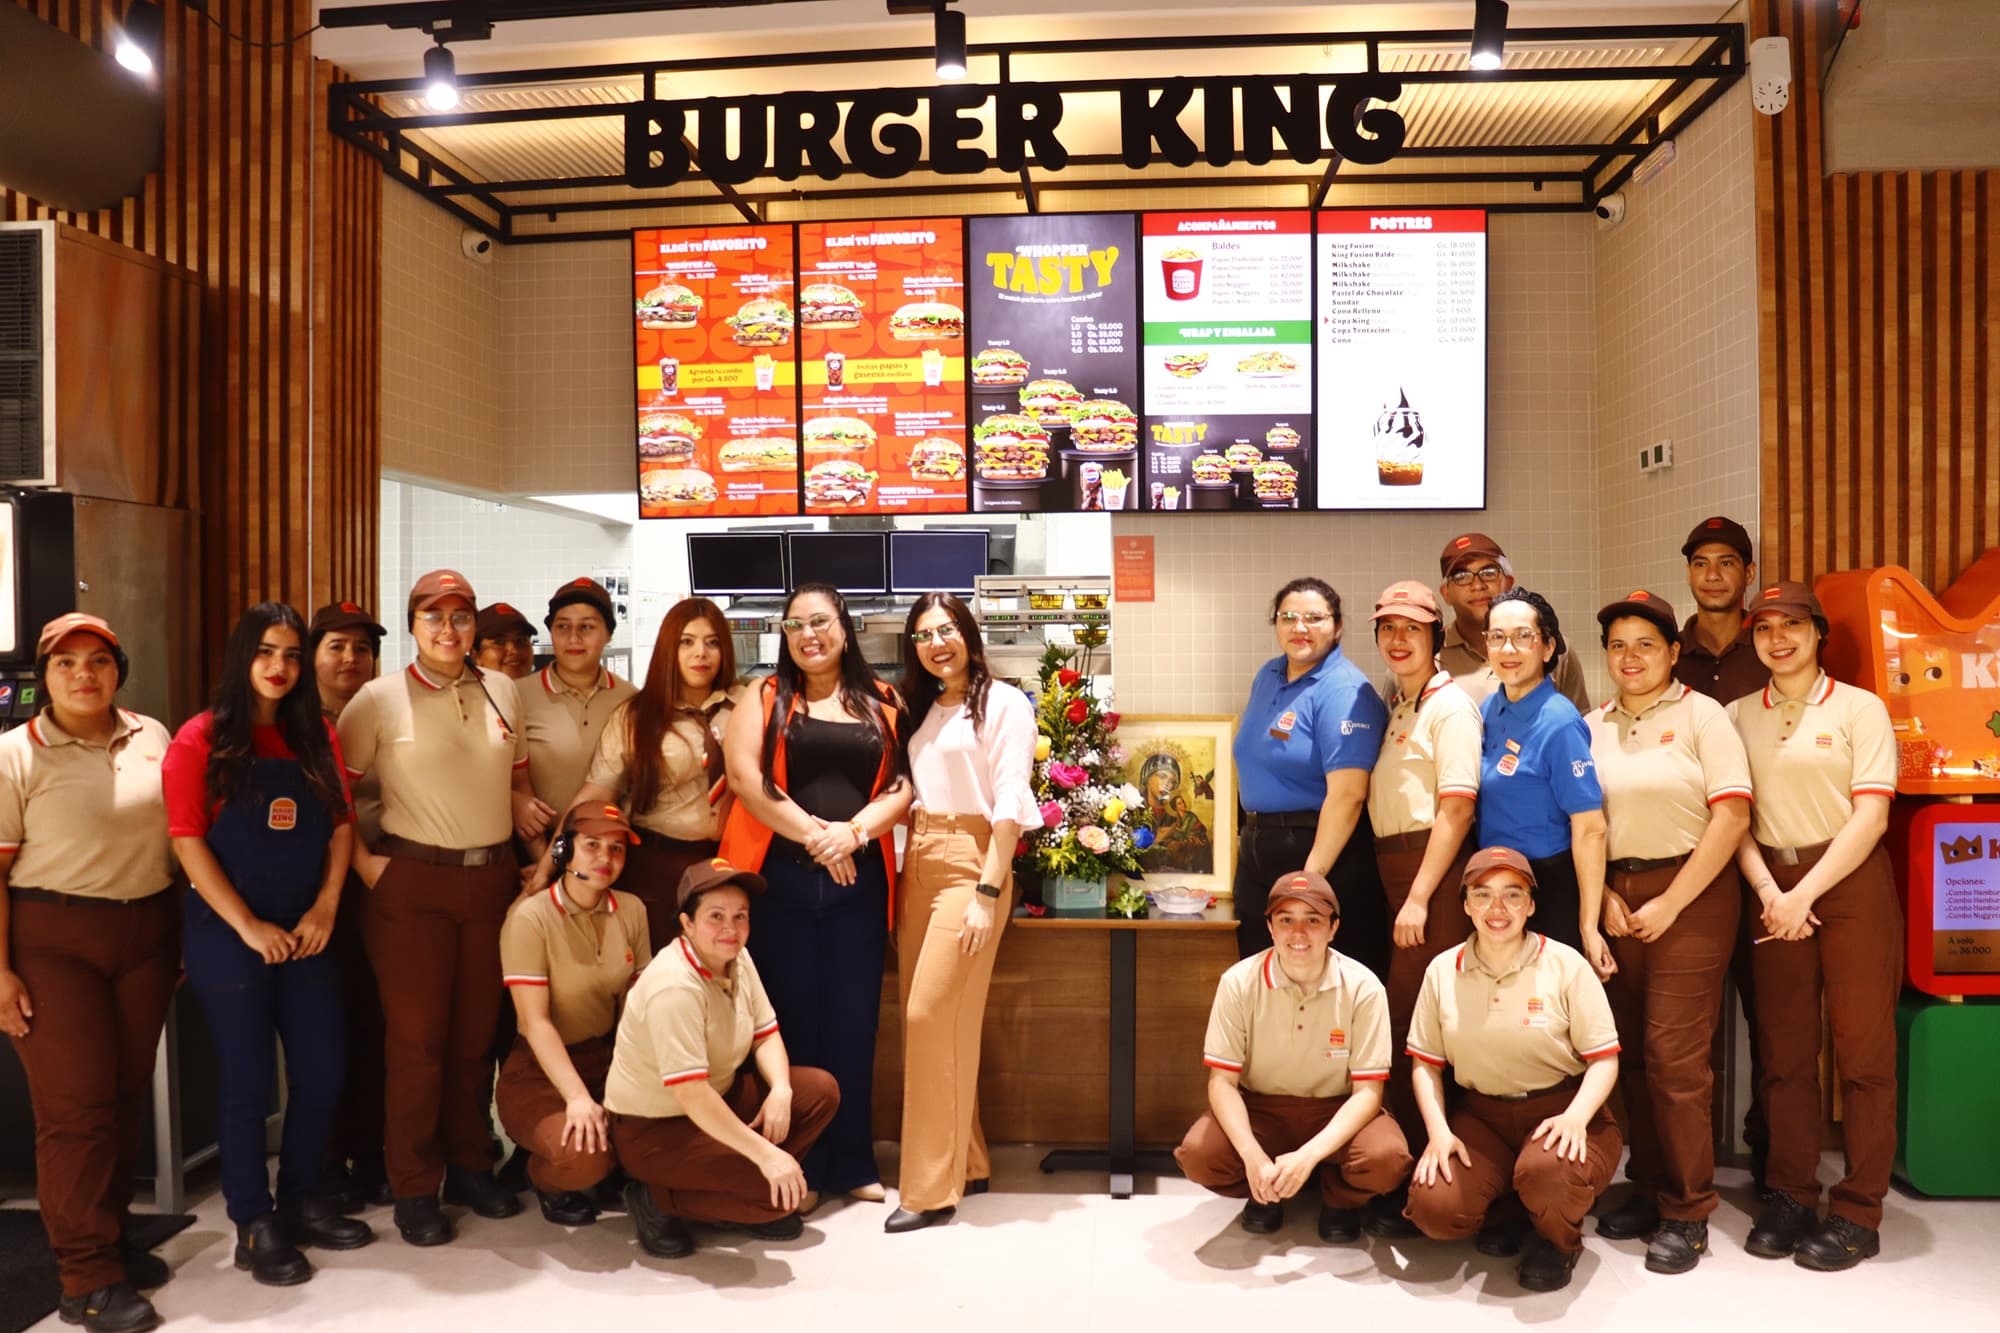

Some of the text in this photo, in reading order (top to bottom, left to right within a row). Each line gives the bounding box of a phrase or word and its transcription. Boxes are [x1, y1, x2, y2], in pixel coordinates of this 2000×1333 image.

[623, 76, 1405, 187] BURGER KING
[1178, 219, 1276, 232] ACOMPAÑAMIENTOS
[1370, 217, 1432, 230] POSTRES
[689, 242, 702, 252] TU
[703, 238, 767, 252] FAVORITO
[856, 237, 868, 246] TU
[870, 232, 936, 245] FAVORITO
[1016, 244, 1088, 256] WHOPPER
[1212, 242, 1240, 250] Baldes
[986, 246, 1120, 295] TASTY
[1214, 328, 1222, 338] Y
[1151, 423, 1208, 444] TASTY
